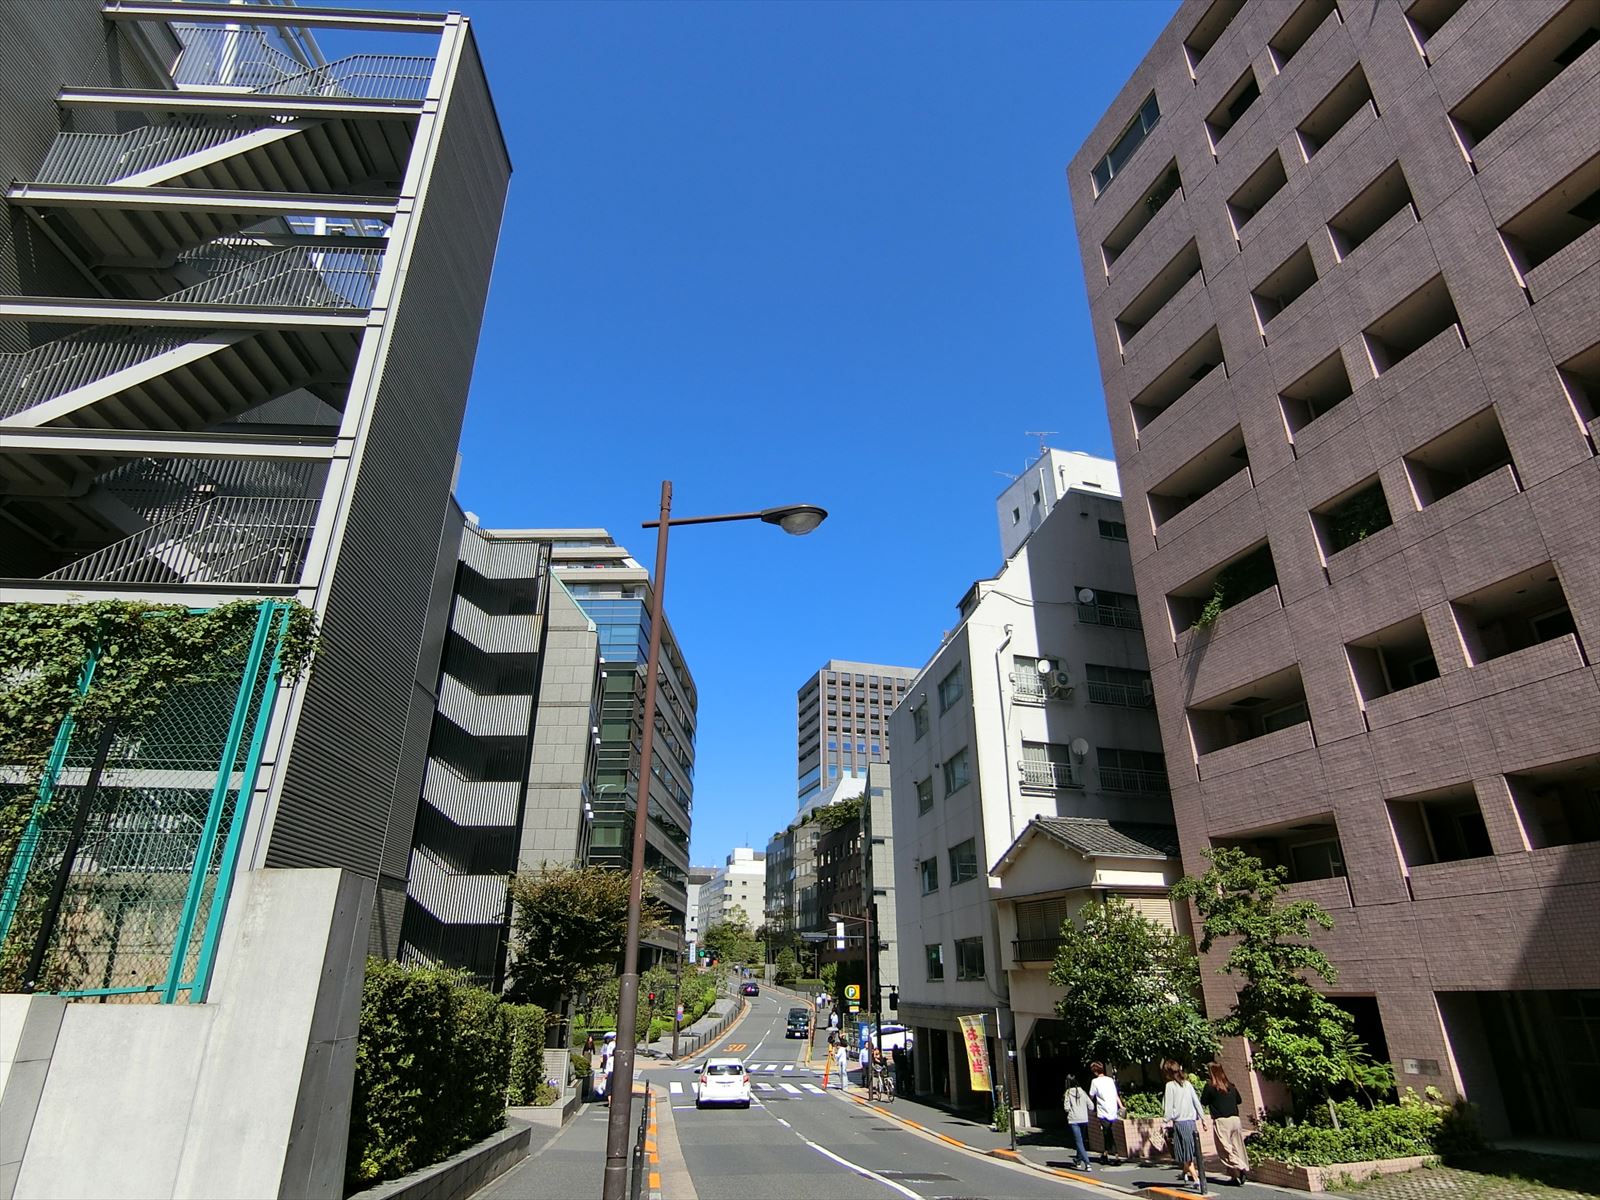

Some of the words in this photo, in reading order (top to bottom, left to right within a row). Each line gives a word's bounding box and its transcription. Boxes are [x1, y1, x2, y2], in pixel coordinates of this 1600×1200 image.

[848, 987, 855, 997] P
[723, 1043, 747, 1052] 30
[966, 1028, 983, 1073] お弁当
